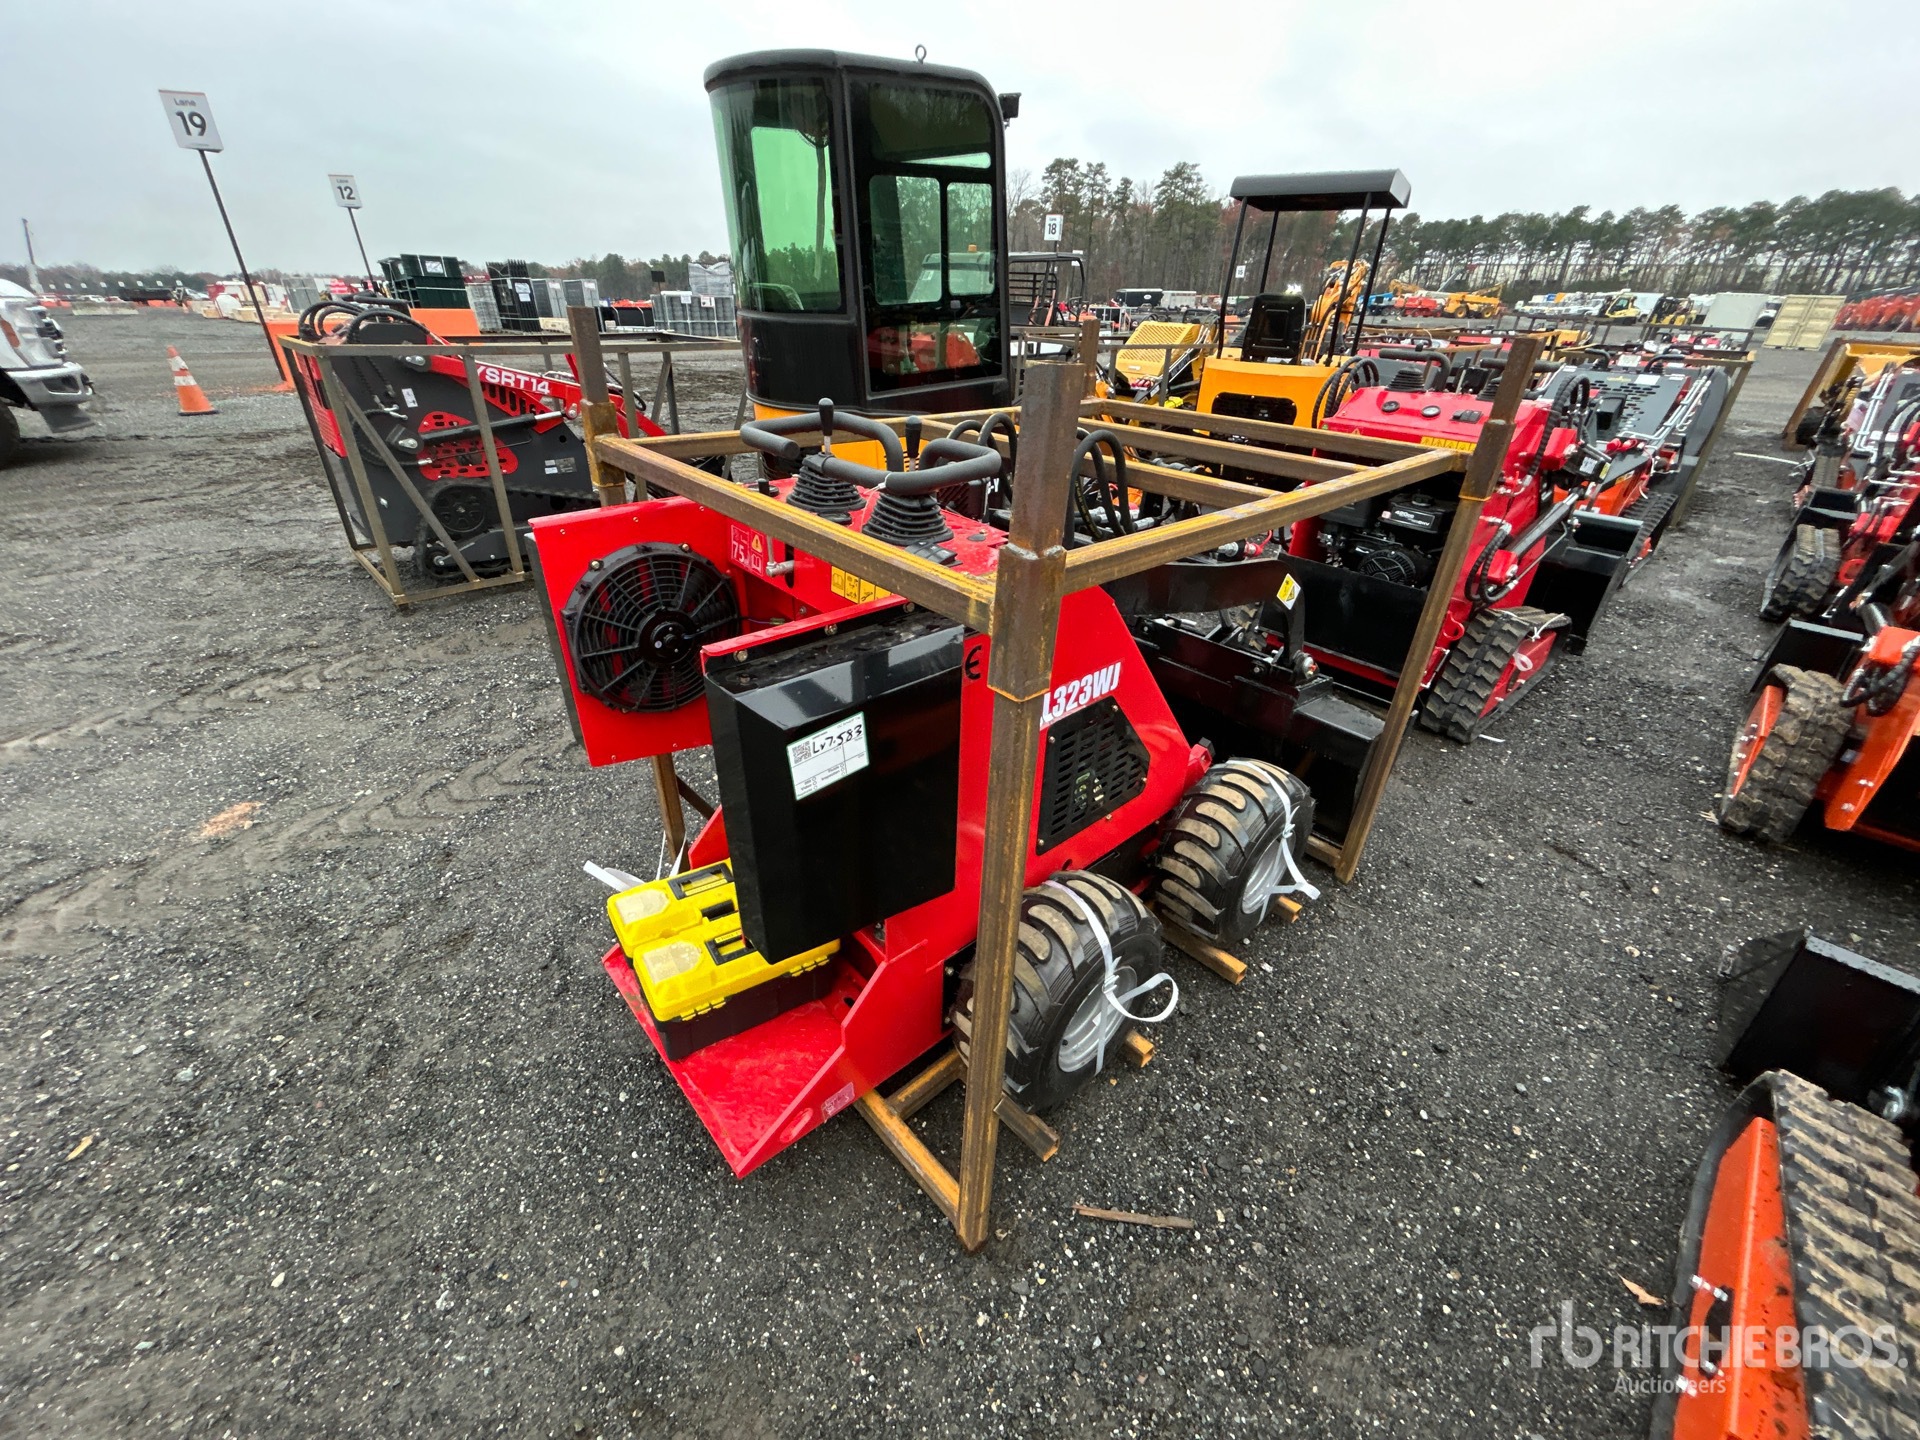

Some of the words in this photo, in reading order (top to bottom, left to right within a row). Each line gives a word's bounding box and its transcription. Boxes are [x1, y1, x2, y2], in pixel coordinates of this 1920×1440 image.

[173, 98, 197, 107] Lane
[175, 110, 207, 137] 19
[336, 185, 356, 200] 12
[1048, 223, 1057, 235] 18
[1040, 661, 1122, 728] L323WJ
